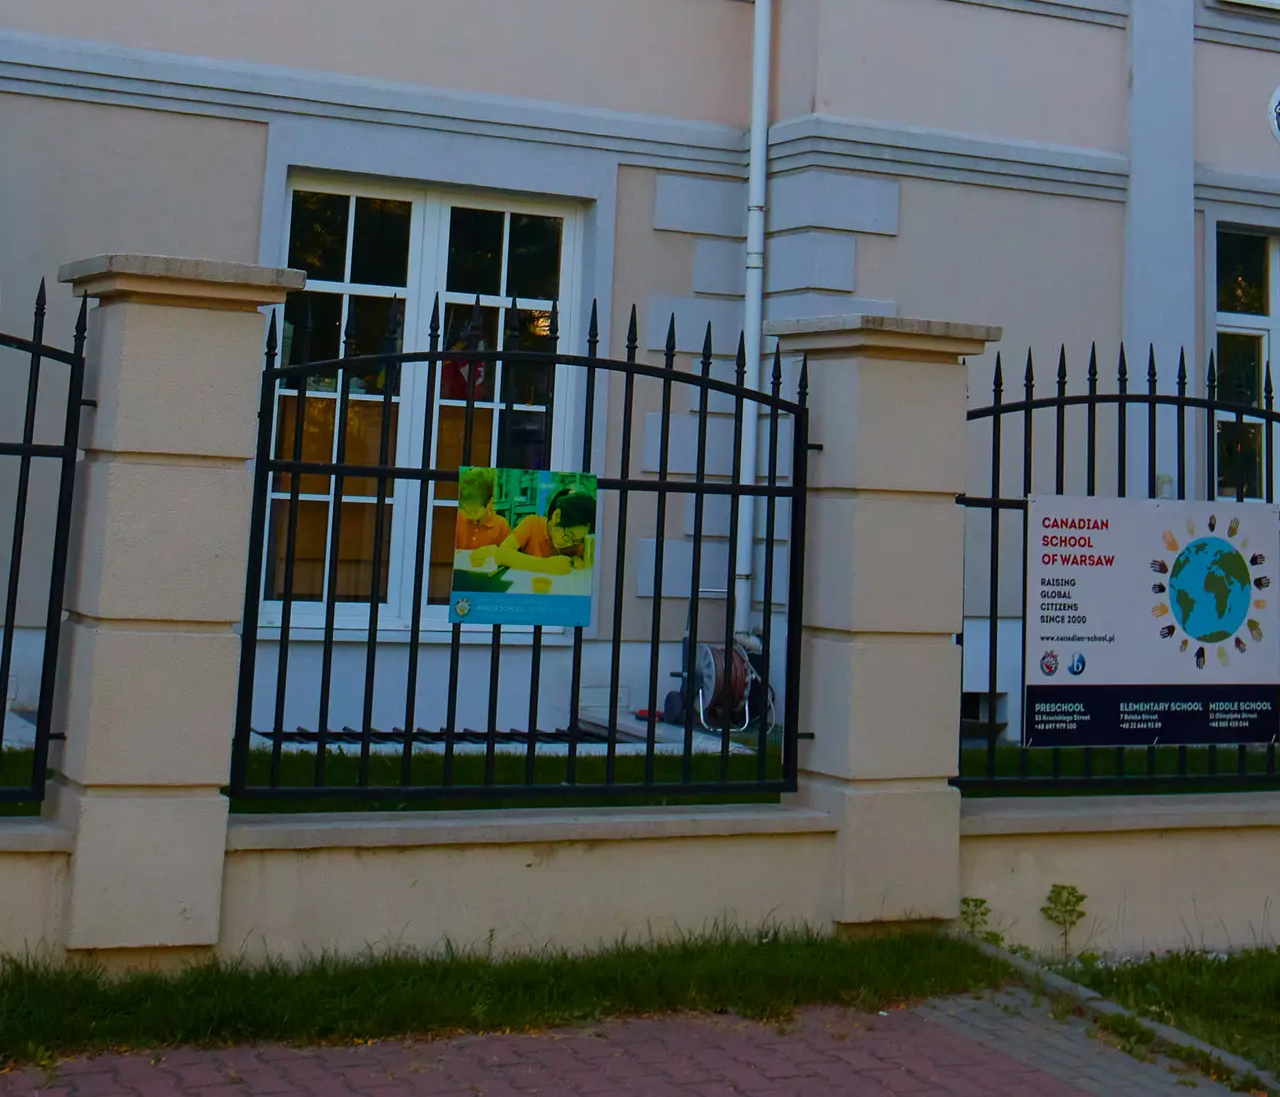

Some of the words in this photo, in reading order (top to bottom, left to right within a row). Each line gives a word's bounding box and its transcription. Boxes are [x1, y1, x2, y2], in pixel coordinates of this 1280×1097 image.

[1041, 517, 1109, 530] CANADIAN
[1041, 535, 1094, 548] SCHOOL
[1041, 553, 1058, 565] OF
[1059, 553, 1115, 567] WARSAW
[1040, 578, 1076, 587] RAISING
[1040, 590, 1072, 599] GLOBAL
[1040, 603, 1079, 611] CITIZENS
[1040, 615, 1066, 624] SINCE
[1067, 615, 1087, 624] 2000
[1035, 703, 1085, 712] PRESCHOOL
[1120, 702, 1170, 712] ELEMENTARY
[1170, 702, 1204, 711] SCHOOL
[1209, 701, 1239, 711] MIDDLE
[1239, 701, 1272, 711] SCHOOL
